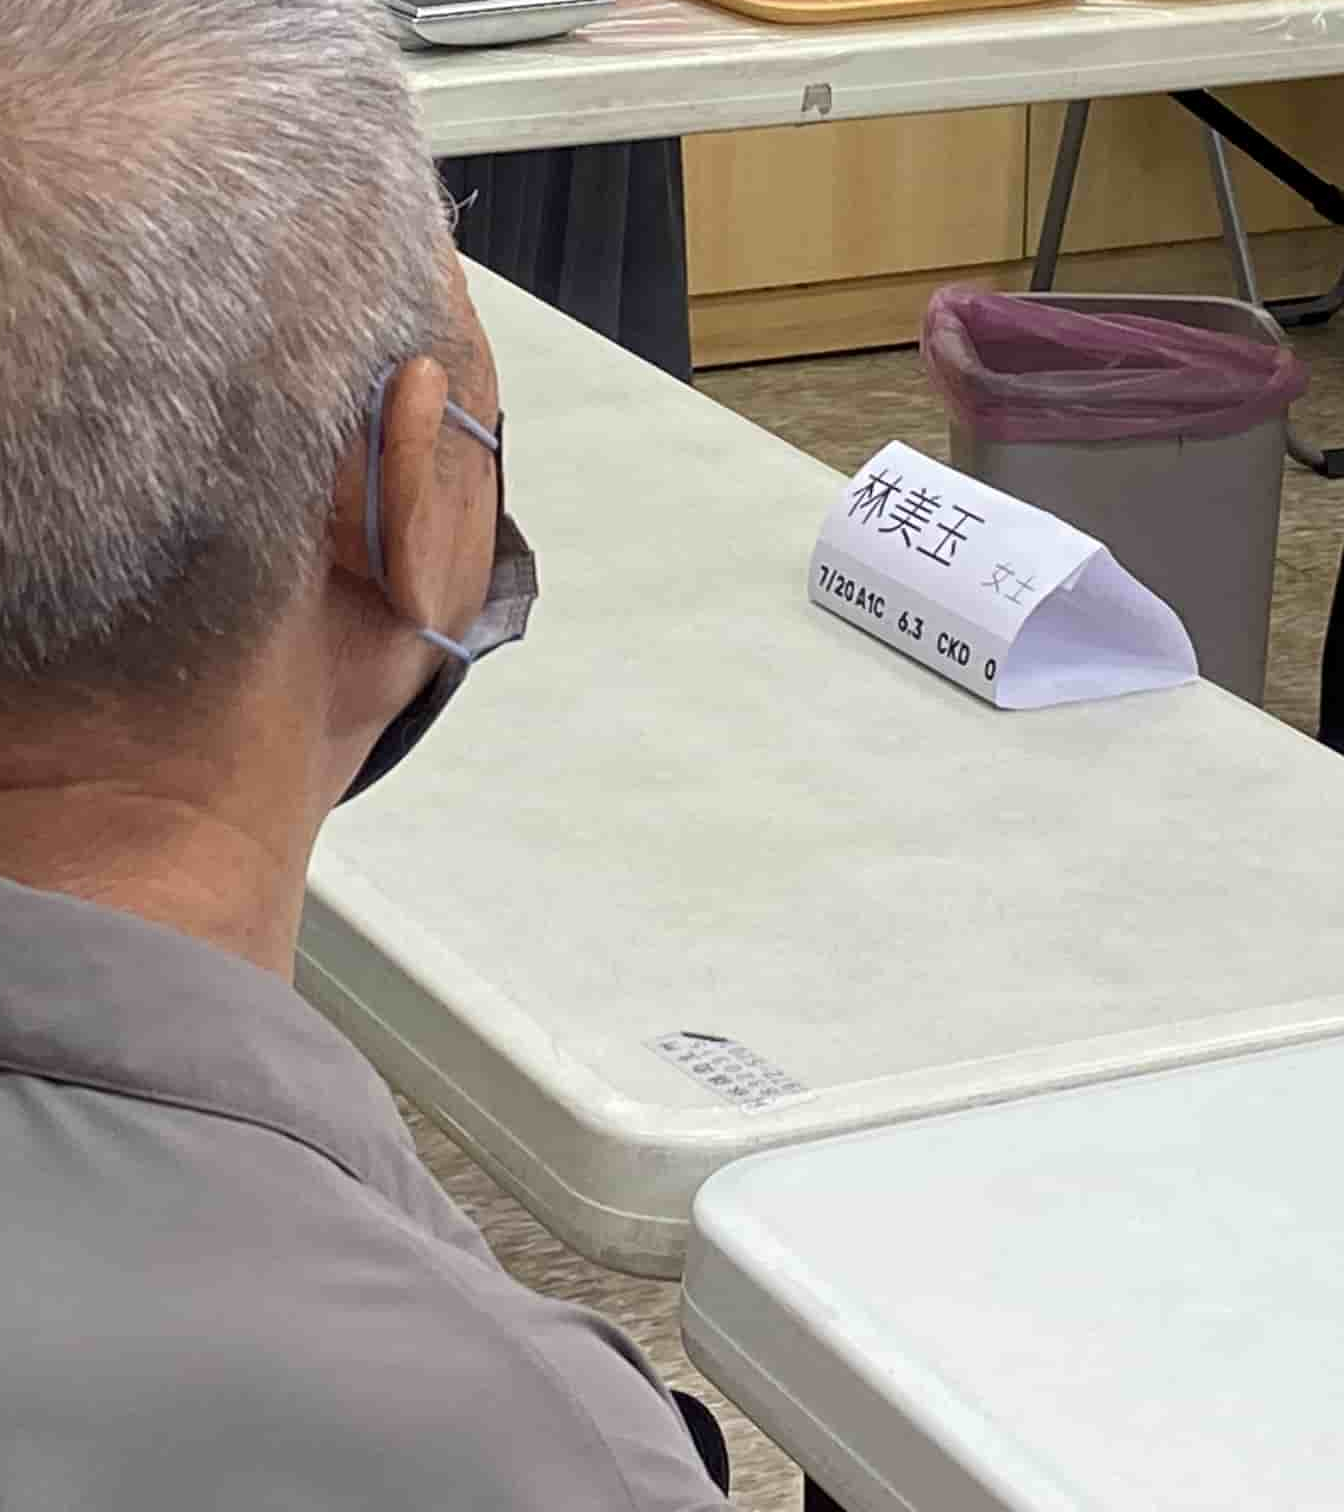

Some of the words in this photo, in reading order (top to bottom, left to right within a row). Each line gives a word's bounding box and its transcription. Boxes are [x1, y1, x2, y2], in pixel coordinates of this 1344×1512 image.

[848, 468, 986, 566] 林美玉
[981, 561, 1038, 605] 女士
[897, 610, 924, 641] 6.3
[937, 631, 970, 667] CKD
